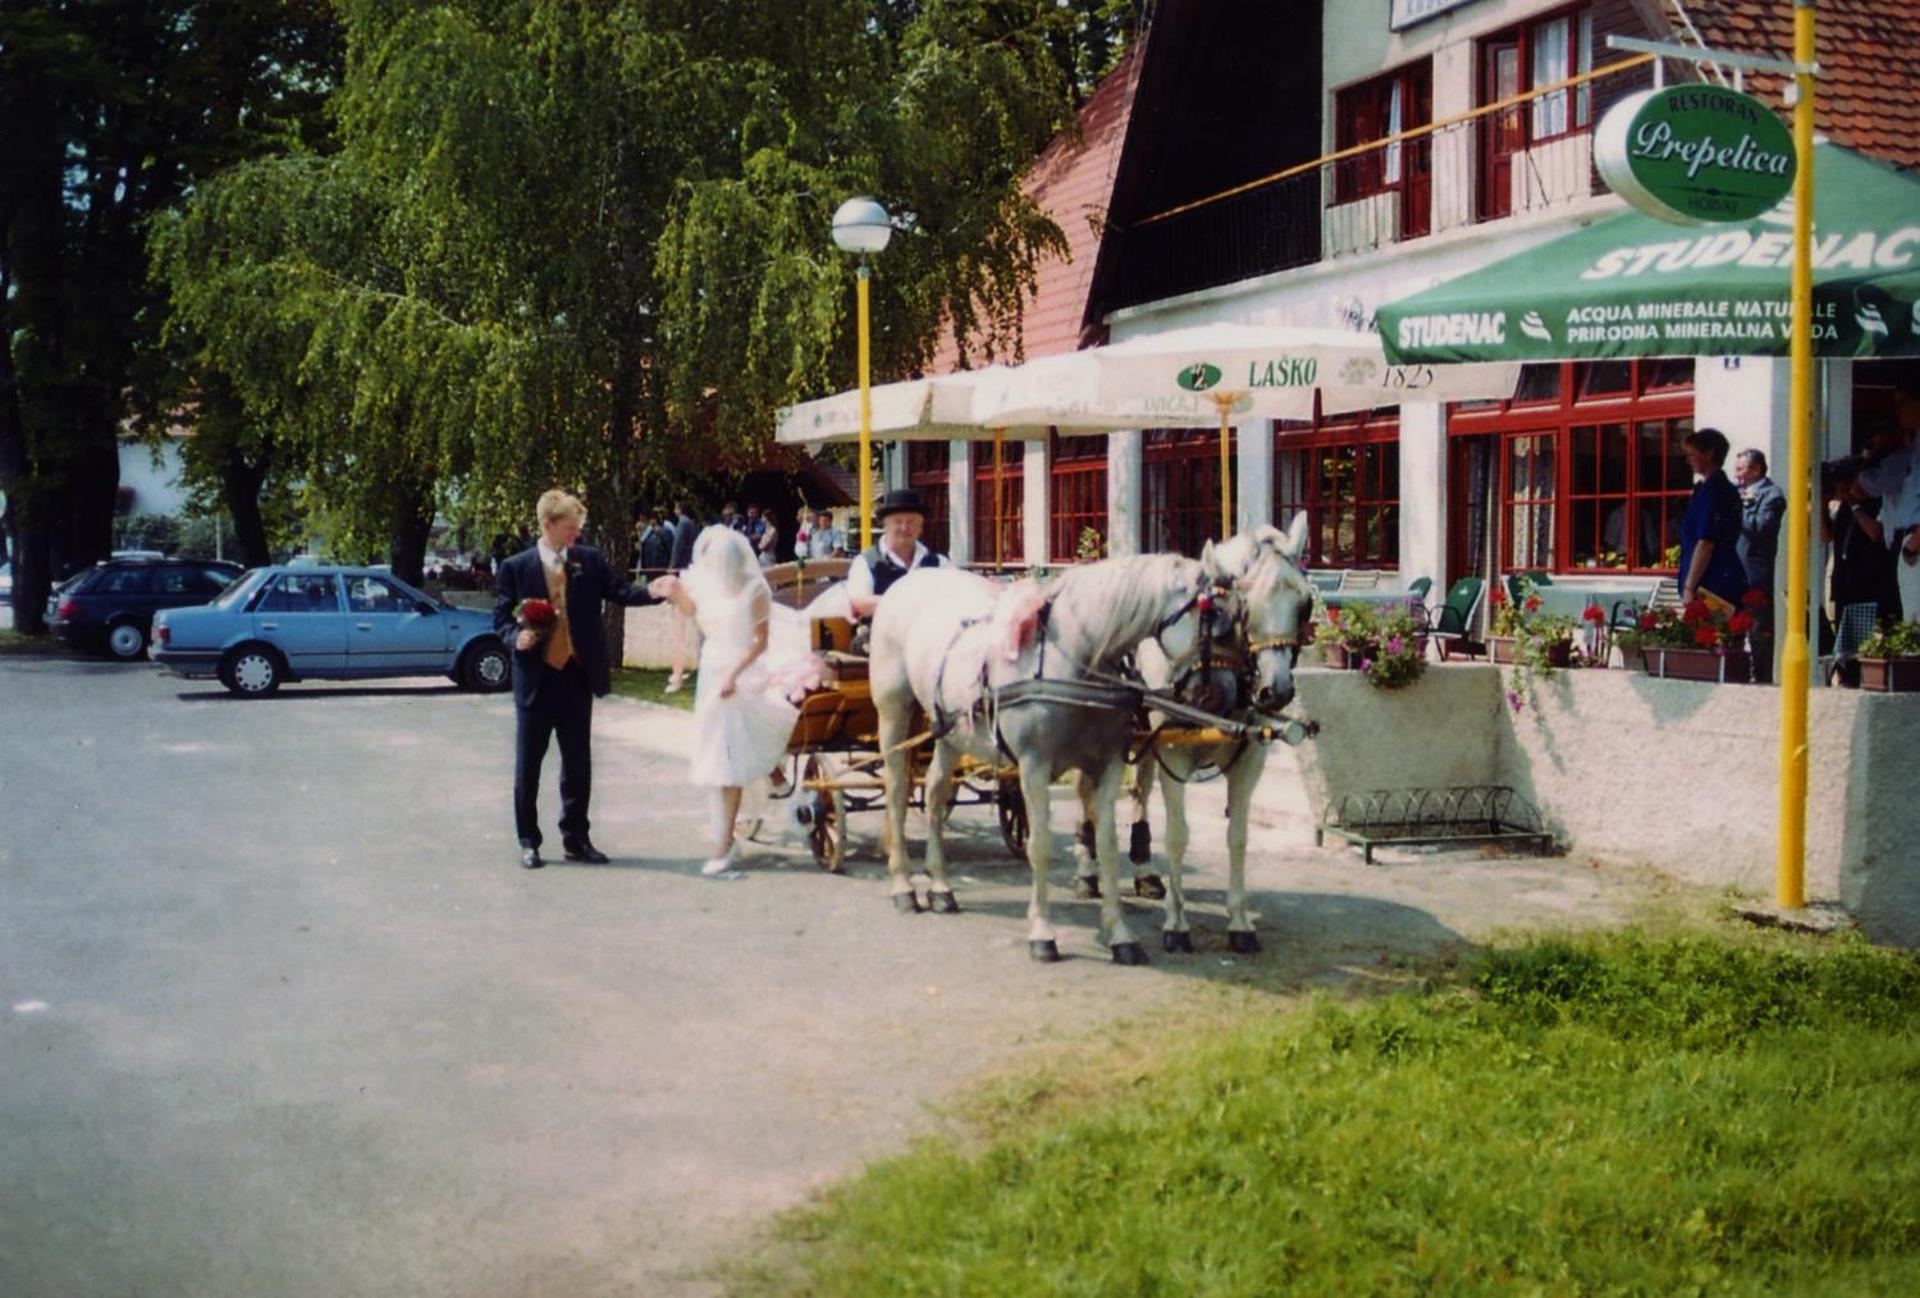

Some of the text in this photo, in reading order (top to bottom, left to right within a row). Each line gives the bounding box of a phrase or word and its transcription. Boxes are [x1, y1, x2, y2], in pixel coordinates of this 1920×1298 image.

[1668, 93, 1760, 125] RESTORAN
[1633, 119, 1789, 180] Prepelica
[1580, 227, 1920, 281] STUDENAC
[1567, 301, 1837, 324] ACQUA MINERALE NATULE
[1399, 311, 1506, 349] STUDENAC
[1567, 321, 1839, 343] PRIRODNA MINERALNA VDA
[1249, 354, 1318, 387] LAŠKO
